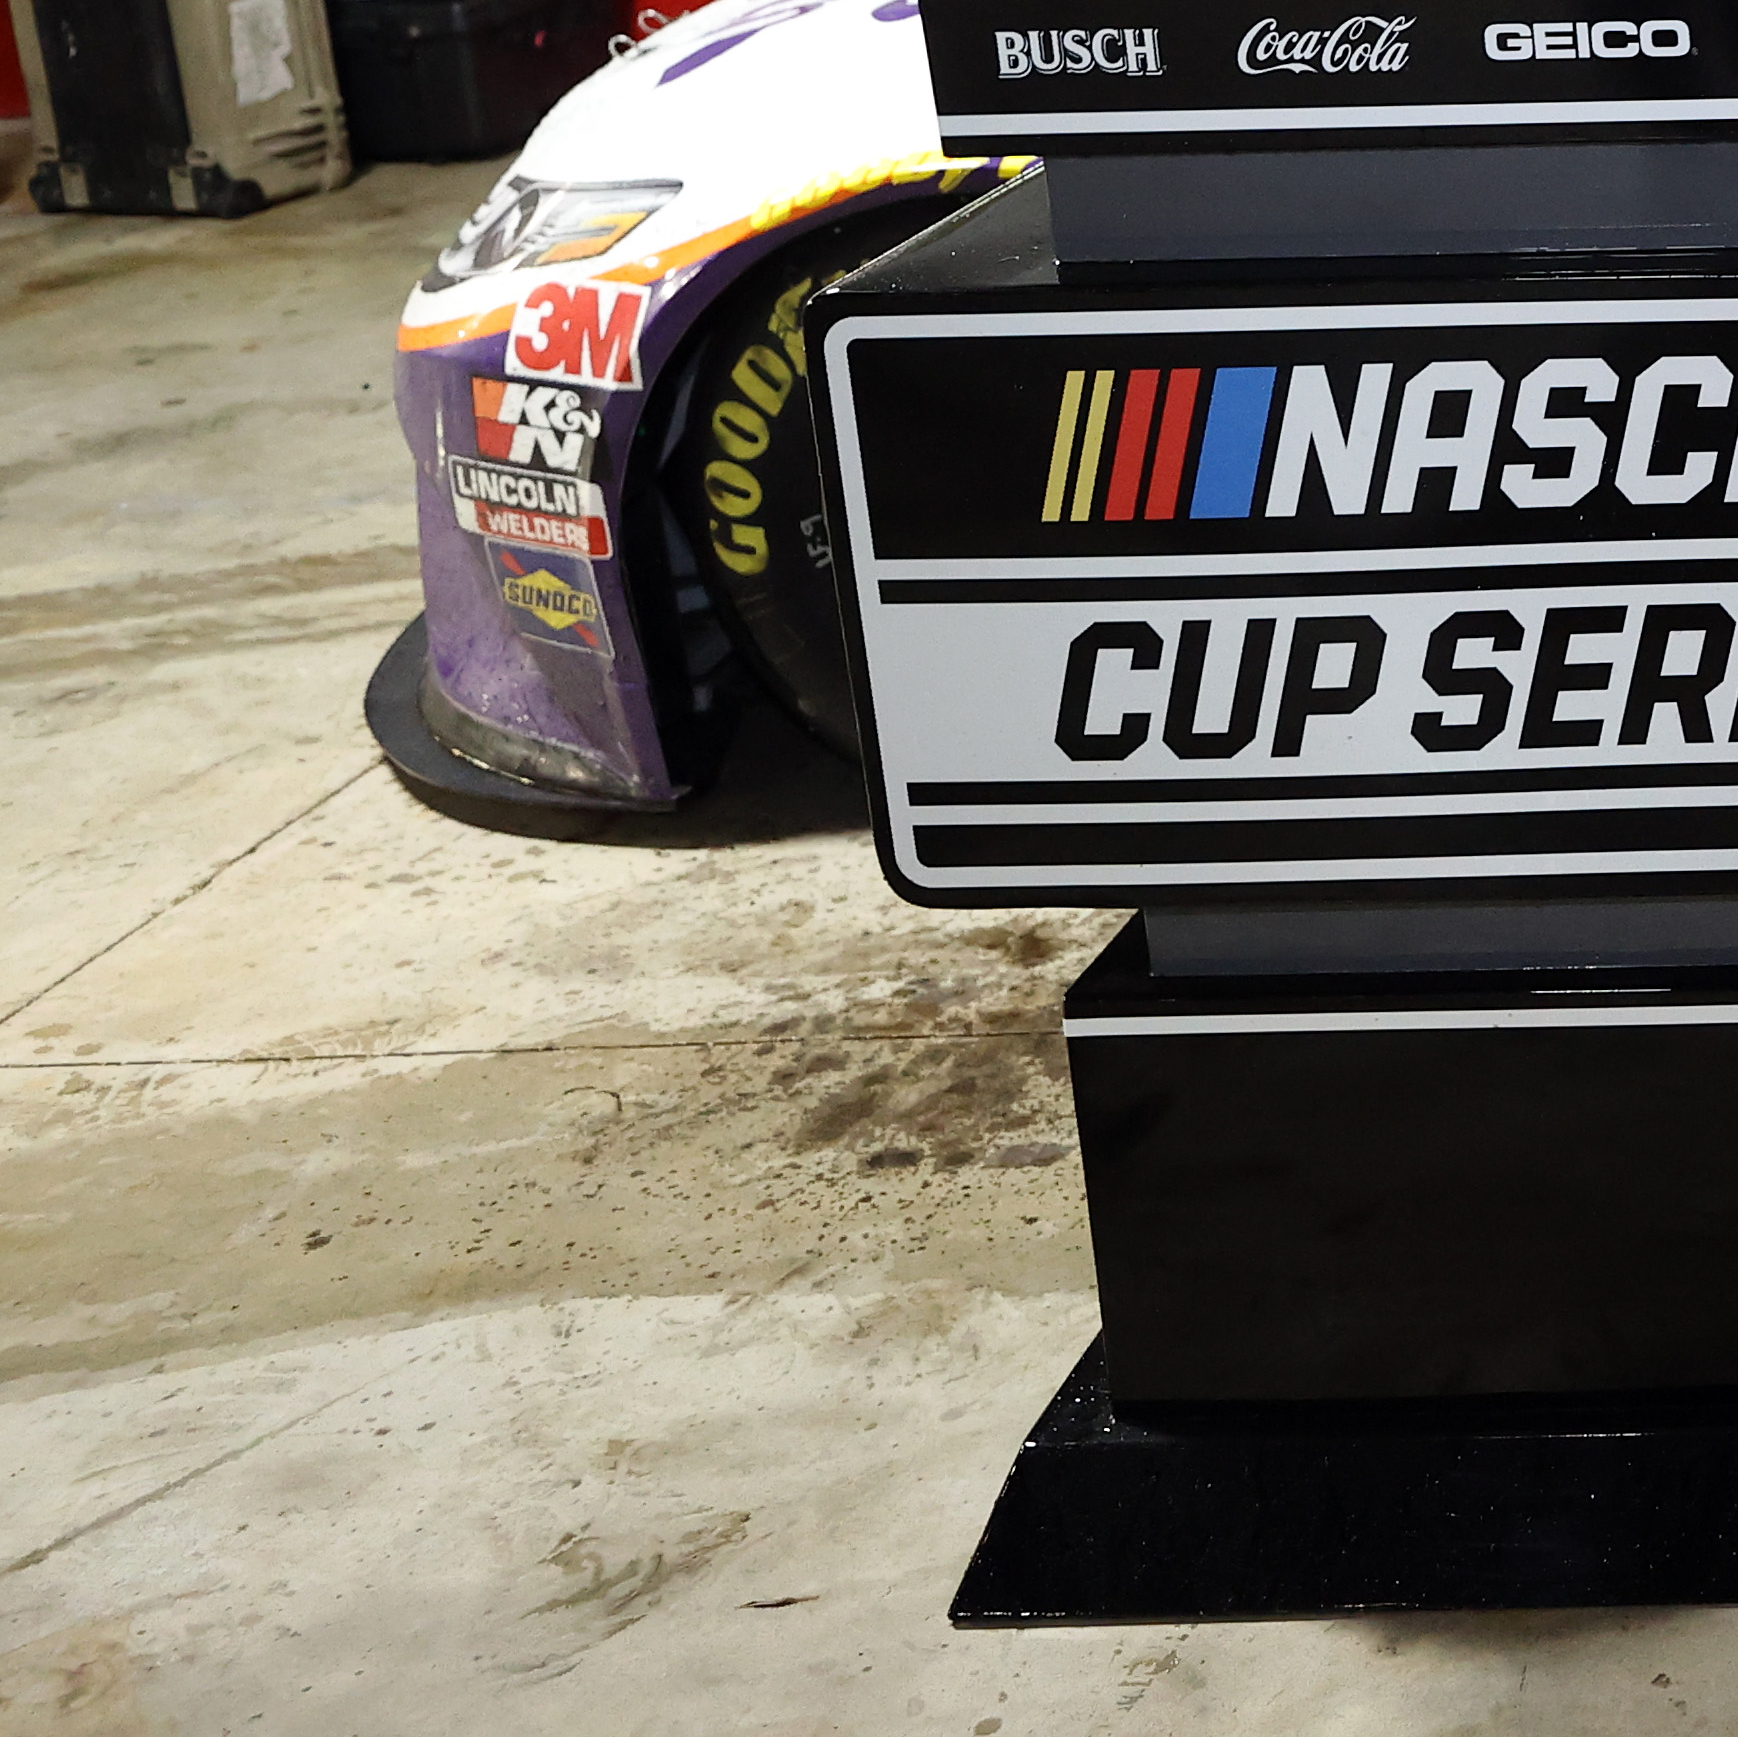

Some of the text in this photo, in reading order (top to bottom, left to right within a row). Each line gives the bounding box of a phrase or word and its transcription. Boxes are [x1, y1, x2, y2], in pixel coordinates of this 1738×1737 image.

[996, 27, 1163, 78] BUSCH
[1238, 14, 1415, 75] Coca-Cola
[1484, 19, 1692, 61] GEICO
[515, 282, 642, 384] 3M
[705, 344, 793, 576] GOOD
[456, 465, 576, 516] LINCOLN
[487, 510, 589, 552] WELDERS
[507, 580, 595, 616] SUNOCO
[1054, 614, 1386, 761] CUP
